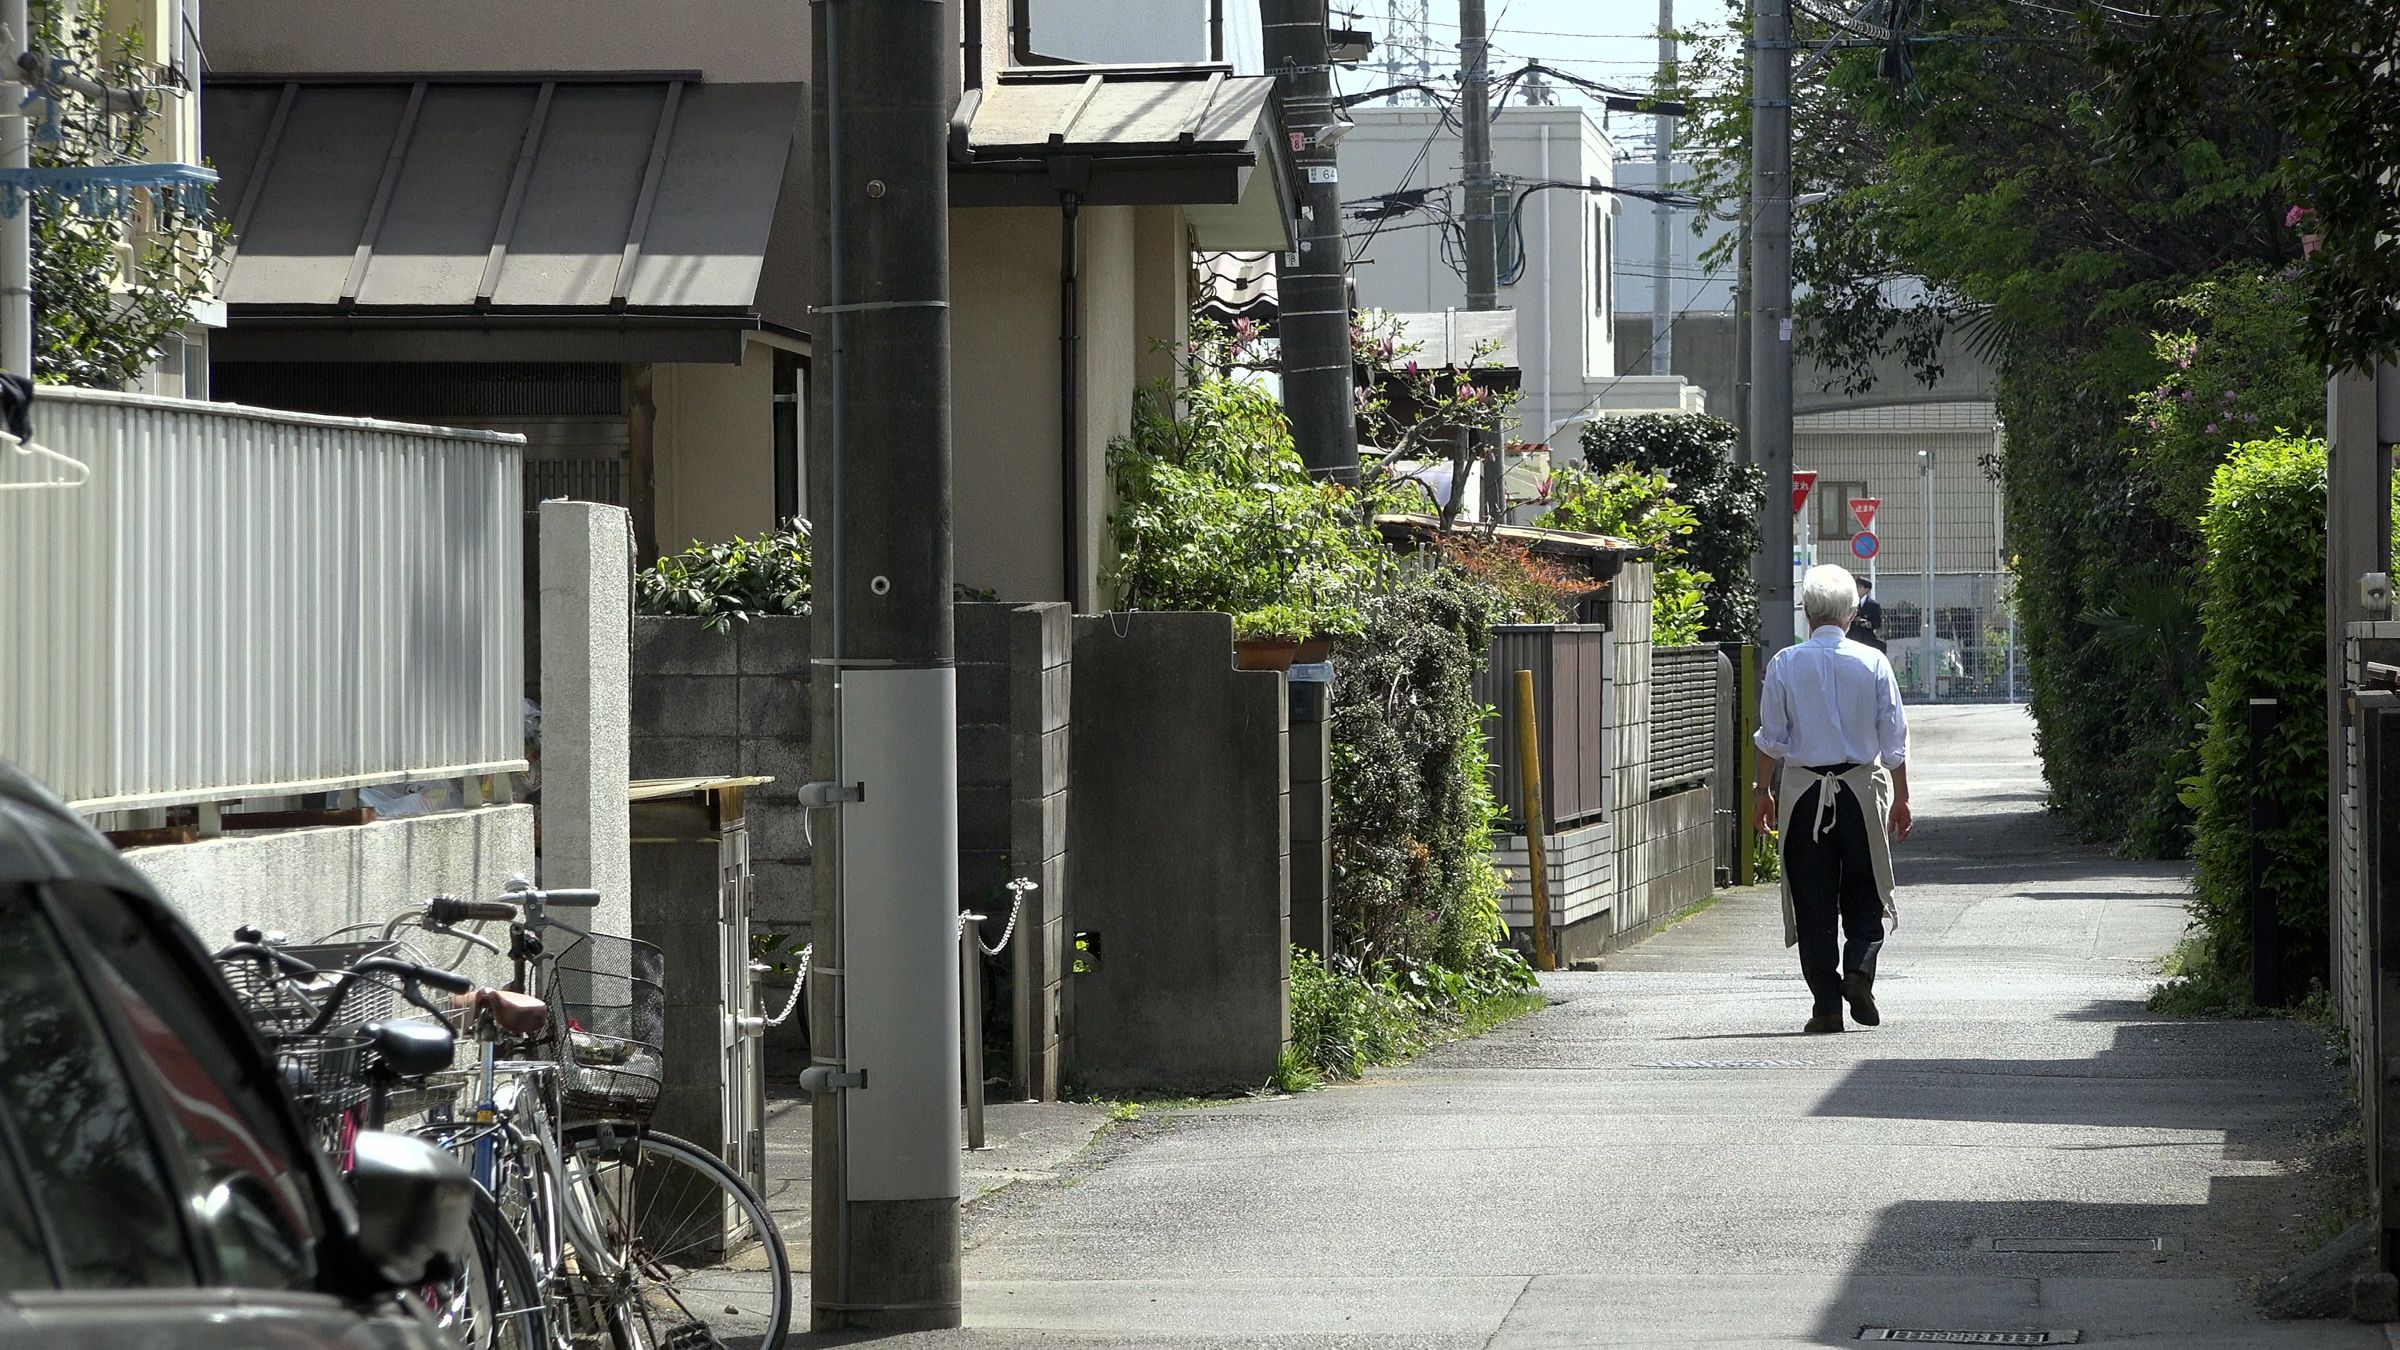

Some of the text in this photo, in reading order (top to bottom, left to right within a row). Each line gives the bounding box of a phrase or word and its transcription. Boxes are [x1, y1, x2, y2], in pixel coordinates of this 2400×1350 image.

[1792, 480, 1809, 491] まれ
[1855, 504, 1876, 513] 止まれ
